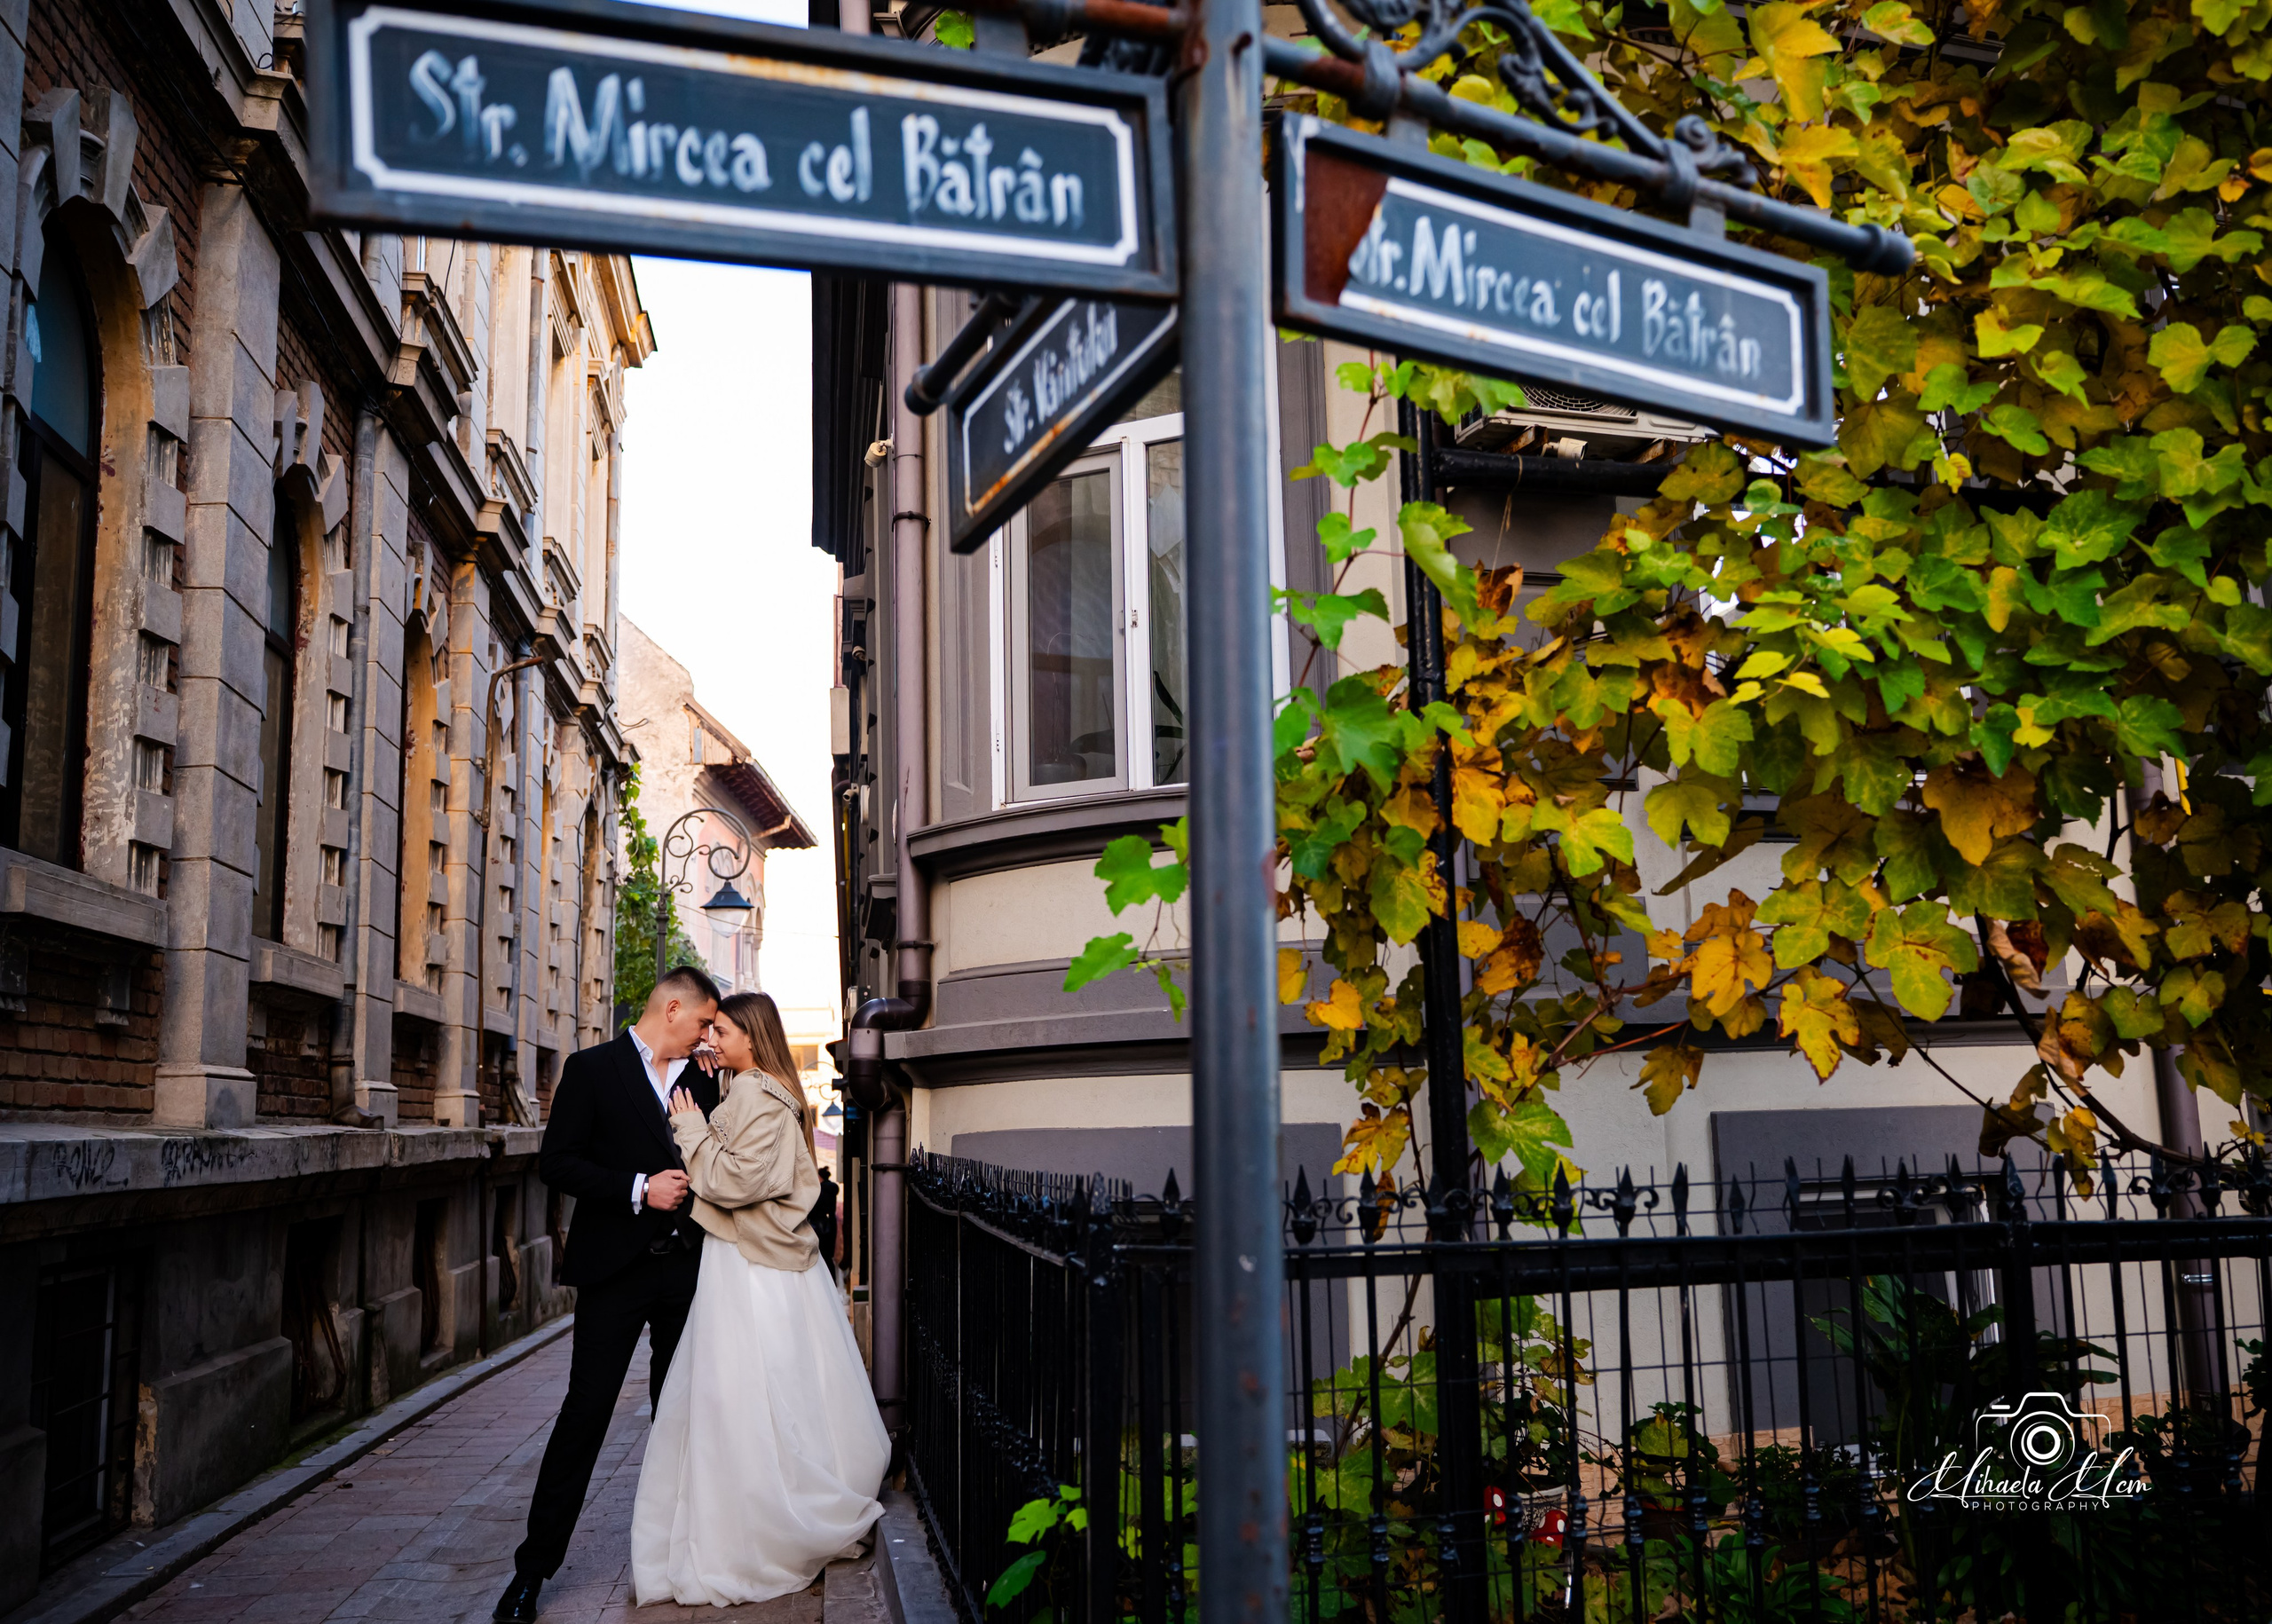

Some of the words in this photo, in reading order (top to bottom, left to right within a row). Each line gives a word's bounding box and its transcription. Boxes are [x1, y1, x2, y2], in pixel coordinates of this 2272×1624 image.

[407, 49, 530, 167] Str.
[543, 66, 771, 193] Mircea
[799, 105, 872, 202] cel
[900, 113, 1084, 227] Bătrân
[1408, 215, 1558, 326] Mircea
[1574, 270, 1622, 343] cel
[1641, 280, 1762, 379] Bătrân
